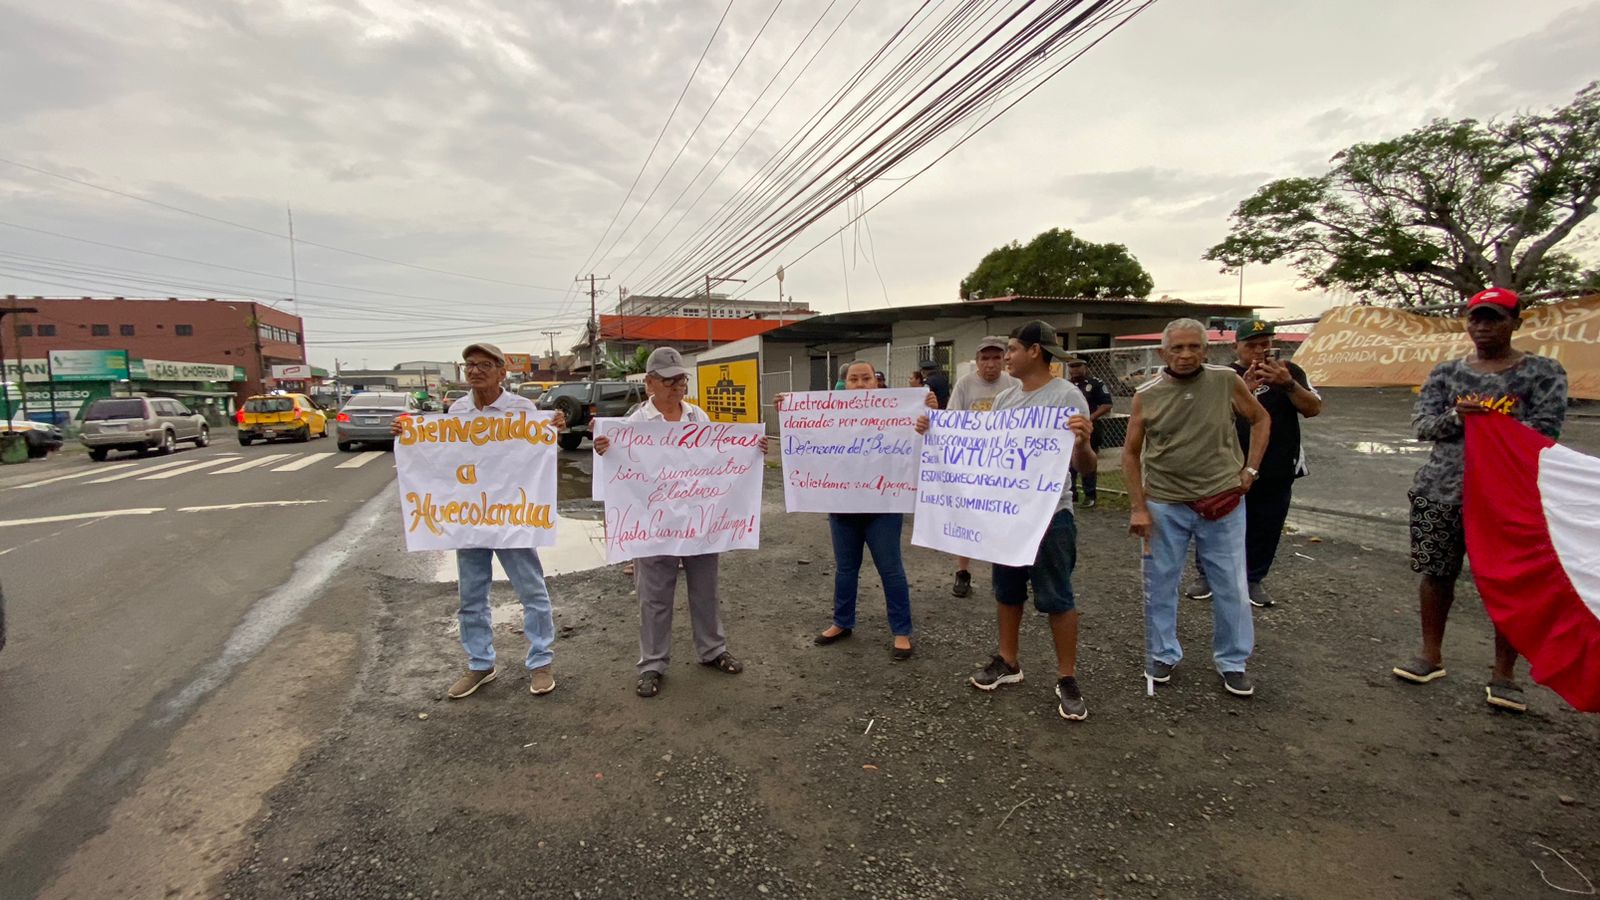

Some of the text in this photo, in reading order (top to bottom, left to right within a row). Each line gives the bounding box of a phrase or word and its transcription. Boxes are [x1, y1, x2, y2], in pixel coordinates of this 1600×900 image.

[1312, 350, 1378, 366] BARRIADA
[1379, 345, 1440, 365] JUAN
[155, 363, 179, 377] CASA
[398, 410, 558, 446] Bienvenidos
[783, 413, 835, 429] dañados
[985, 406, 1076, 431] CONSTANTES
[659, 427, 678, 450] de
[678, 422, 712, 449] 20
[710, 423, 760, 454] Horas
[846, 437, 863, 455] del
[863, 432, 914, 457] Pueblo
[455, 464, 478, 485] a
[609, 464, 650, 484] sin
[789, 469, 851, 488] Solicitamos
[942, 470, 1031, 491] SOBRECARGADAS
[1036, 474, 1063, 493] LAS
[405, 487, 555, 537] Huecolandia
[955, 496, 1021, 516] SUMINISTRO
